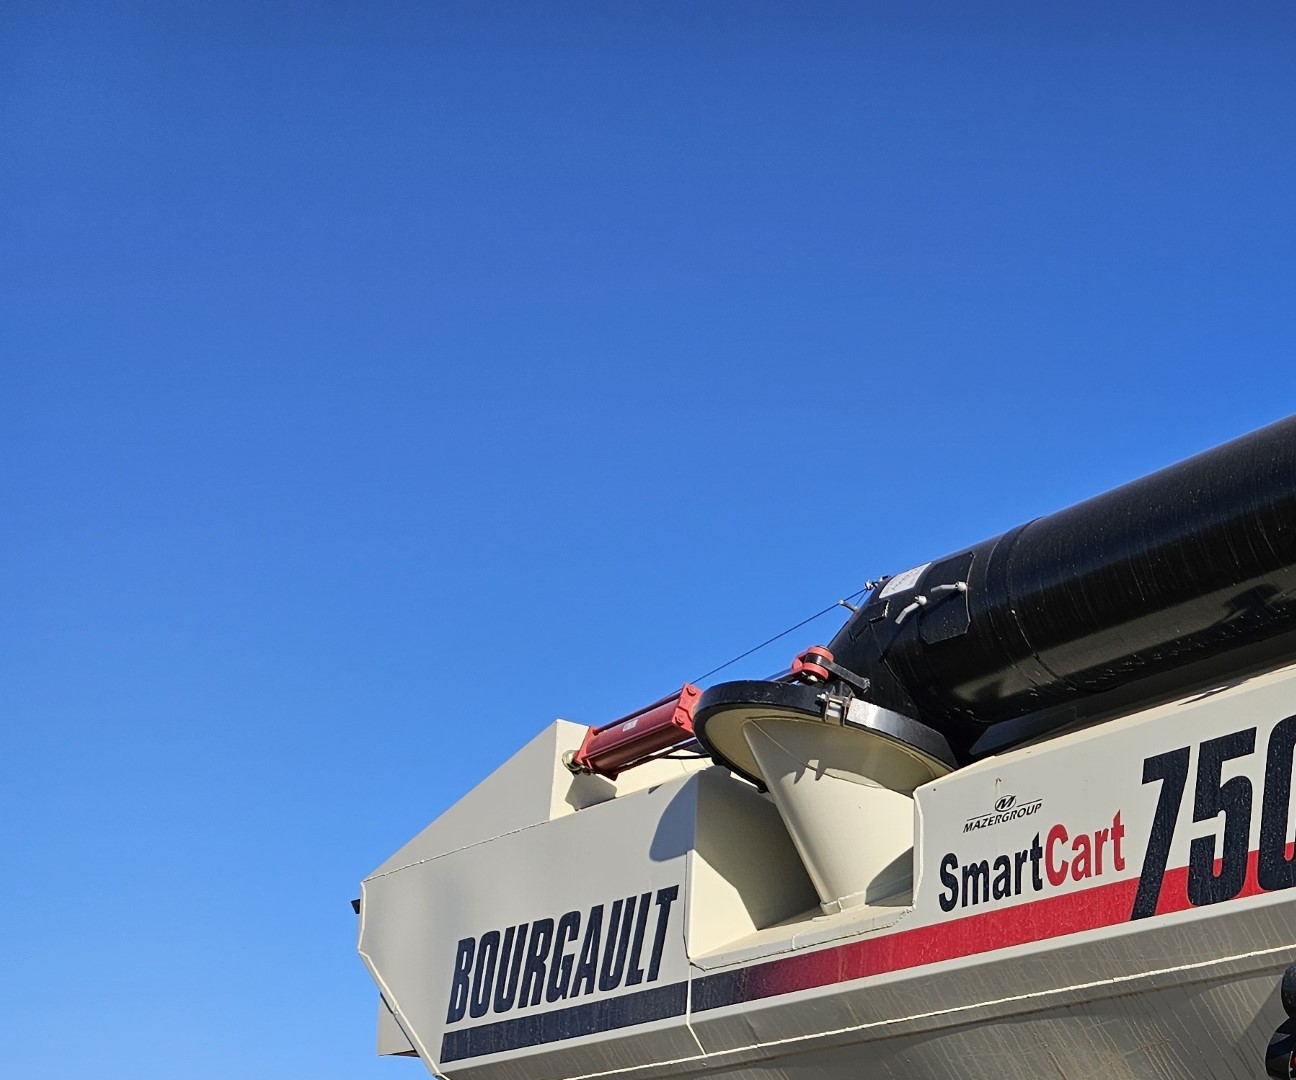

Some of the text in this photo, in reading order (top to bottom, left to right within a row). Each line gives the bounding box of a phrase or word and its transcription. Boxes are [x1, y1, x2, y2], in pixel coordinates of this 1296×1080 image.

[939, 809, 1125, 912] SmartCart
[963, 803, 1042, 833] MAZERGROUP
[446, 885, 679, 1024] BOURGAULT
